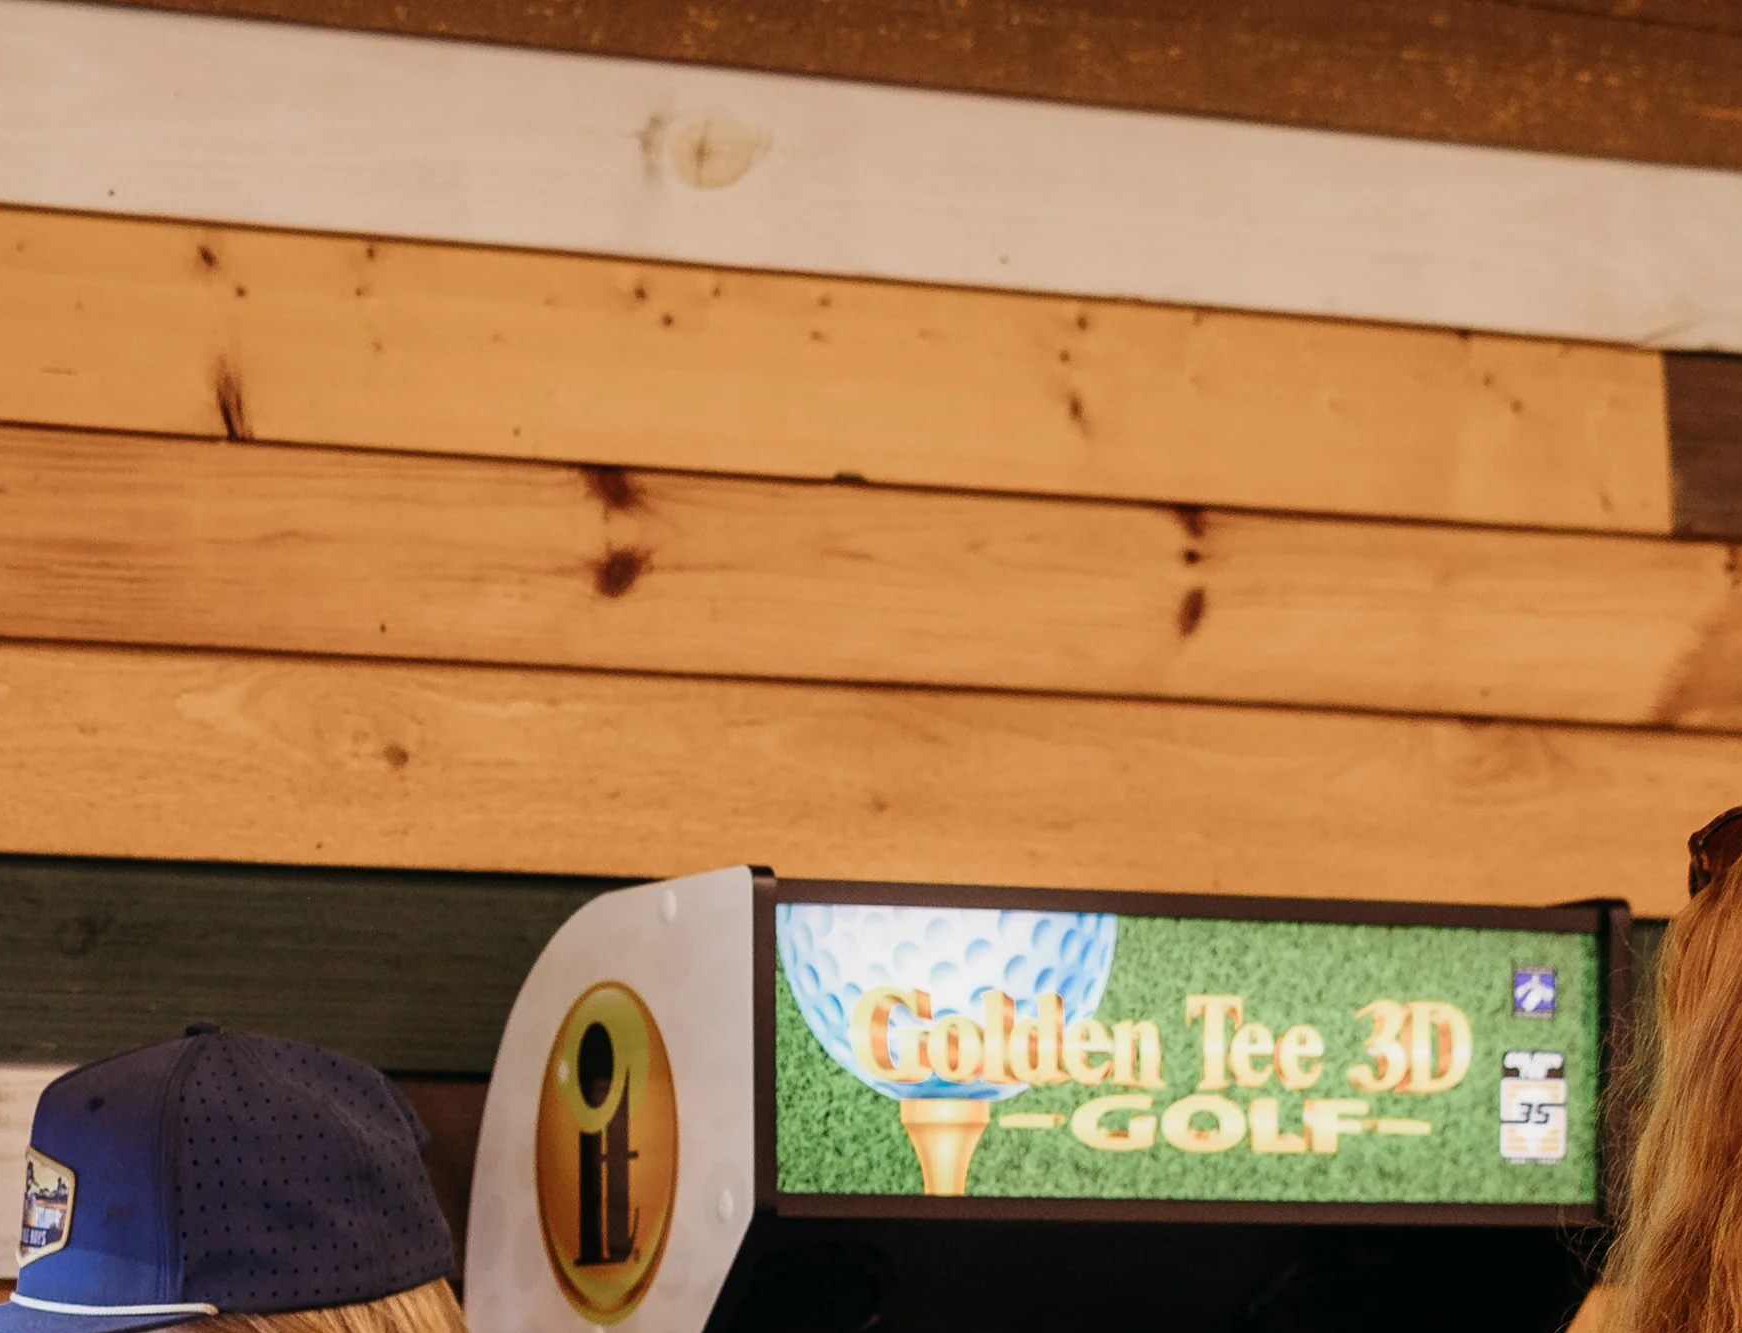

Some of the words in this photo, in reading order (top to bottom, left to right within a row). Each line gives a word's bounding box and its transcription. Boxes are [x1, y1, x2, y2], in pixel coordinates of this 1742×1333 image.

[848, 985, 1165, 1089] Golden
[1185, 993, 1326, 1091] Tee
[1346, 997, 1473, 1094] 3D
